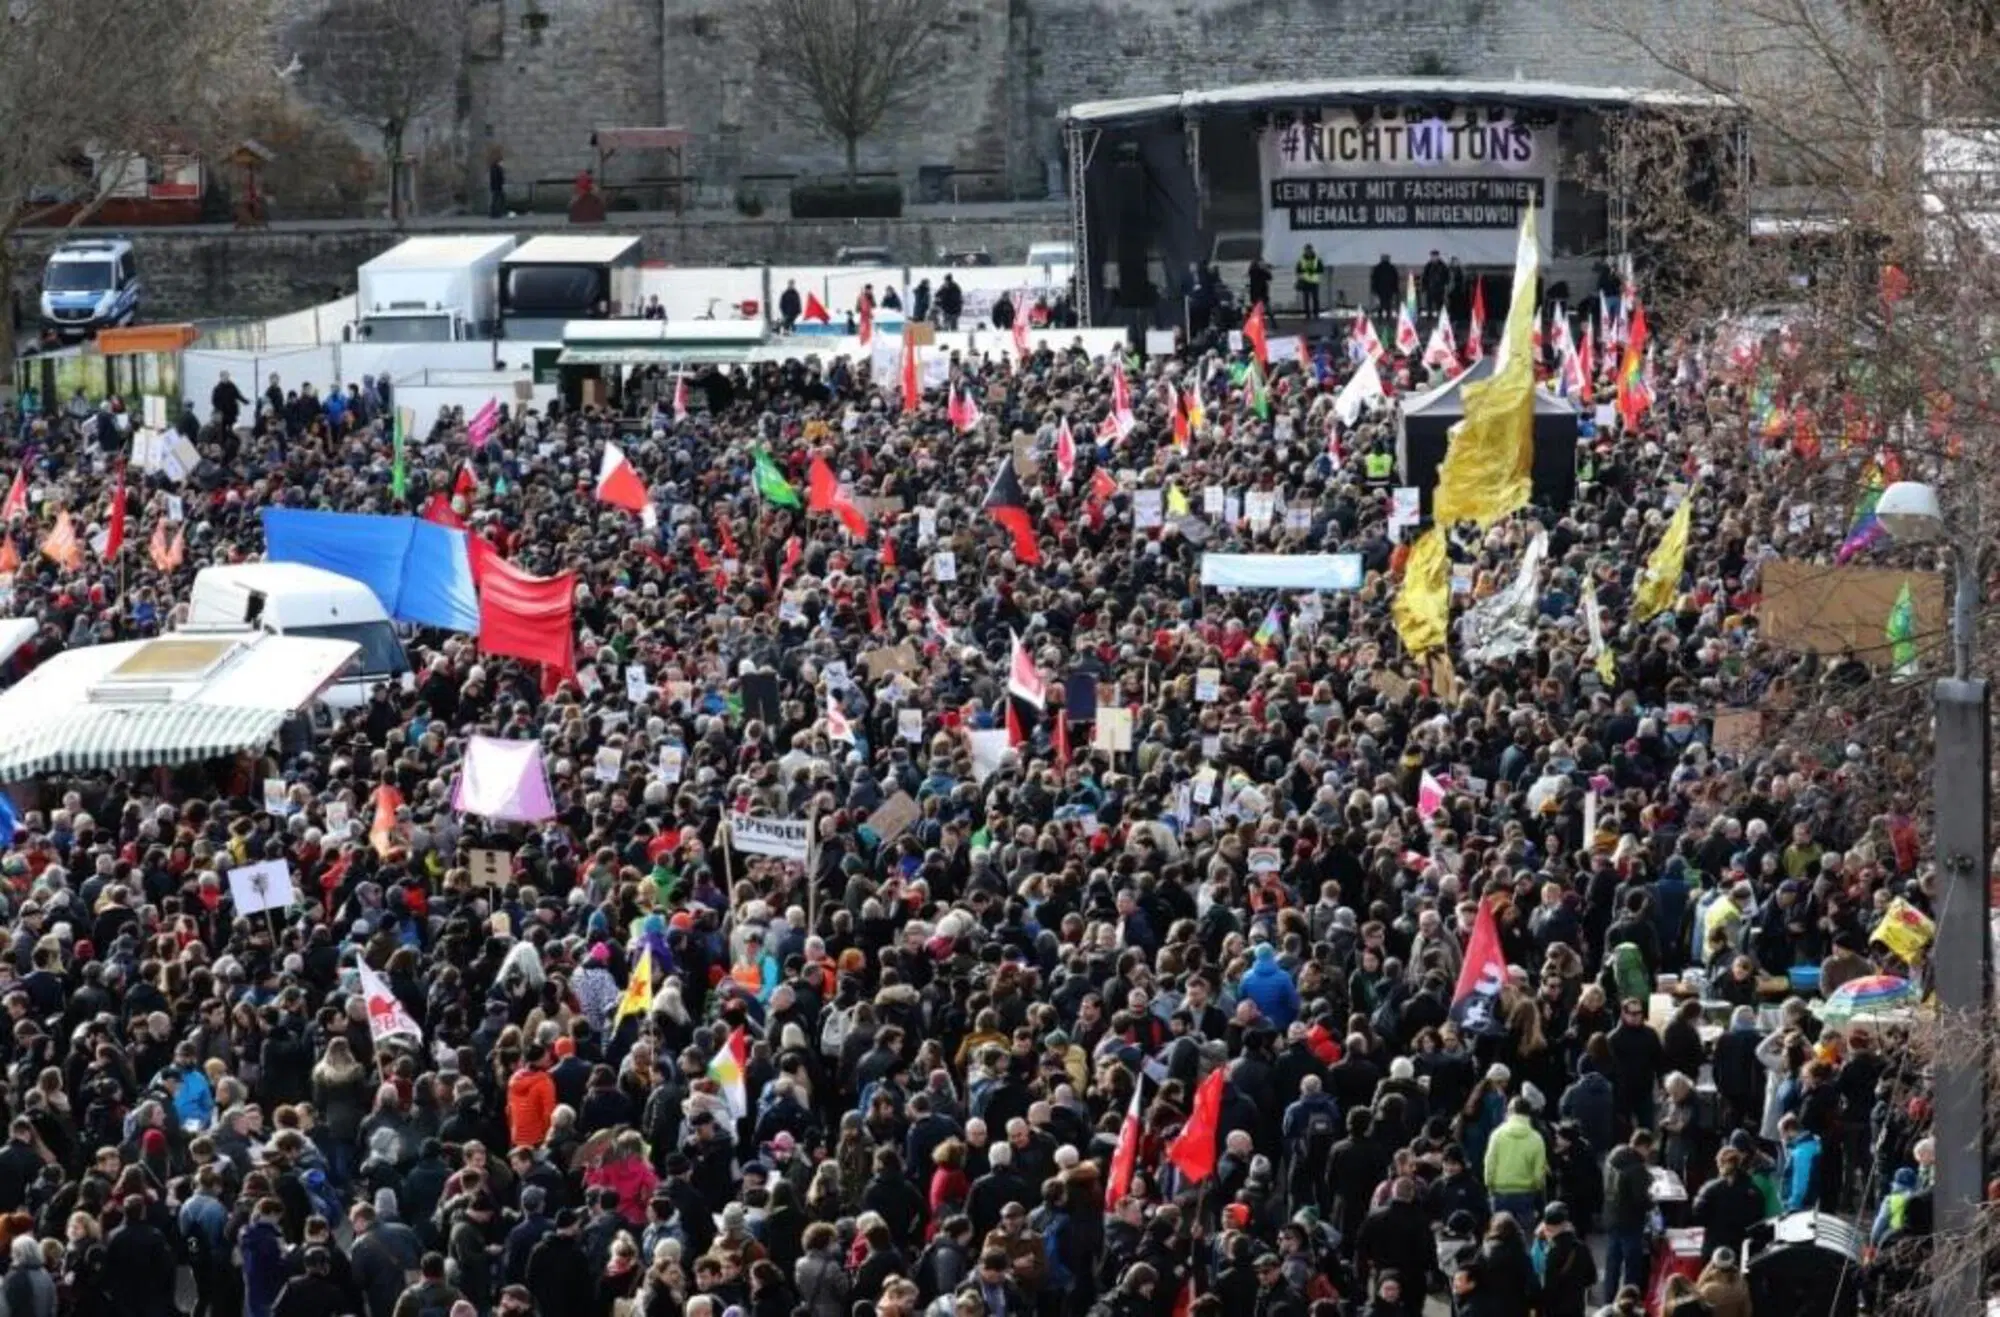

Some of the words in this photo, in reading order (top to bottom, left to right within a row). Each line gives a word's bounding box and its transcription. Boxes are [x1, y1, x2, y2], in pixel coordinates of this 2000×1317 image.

[1317, 181, 1357, 200] PAKT
[1366, 181, 1395, 200] MIT
[1296, 205, 1368, 224] NIEMALS
[1374, 205, 1407, 224] UND
[1415, 205, 1515, 225] NIRGENDWO!
[735, 817, 805, 839] SPENDEN
